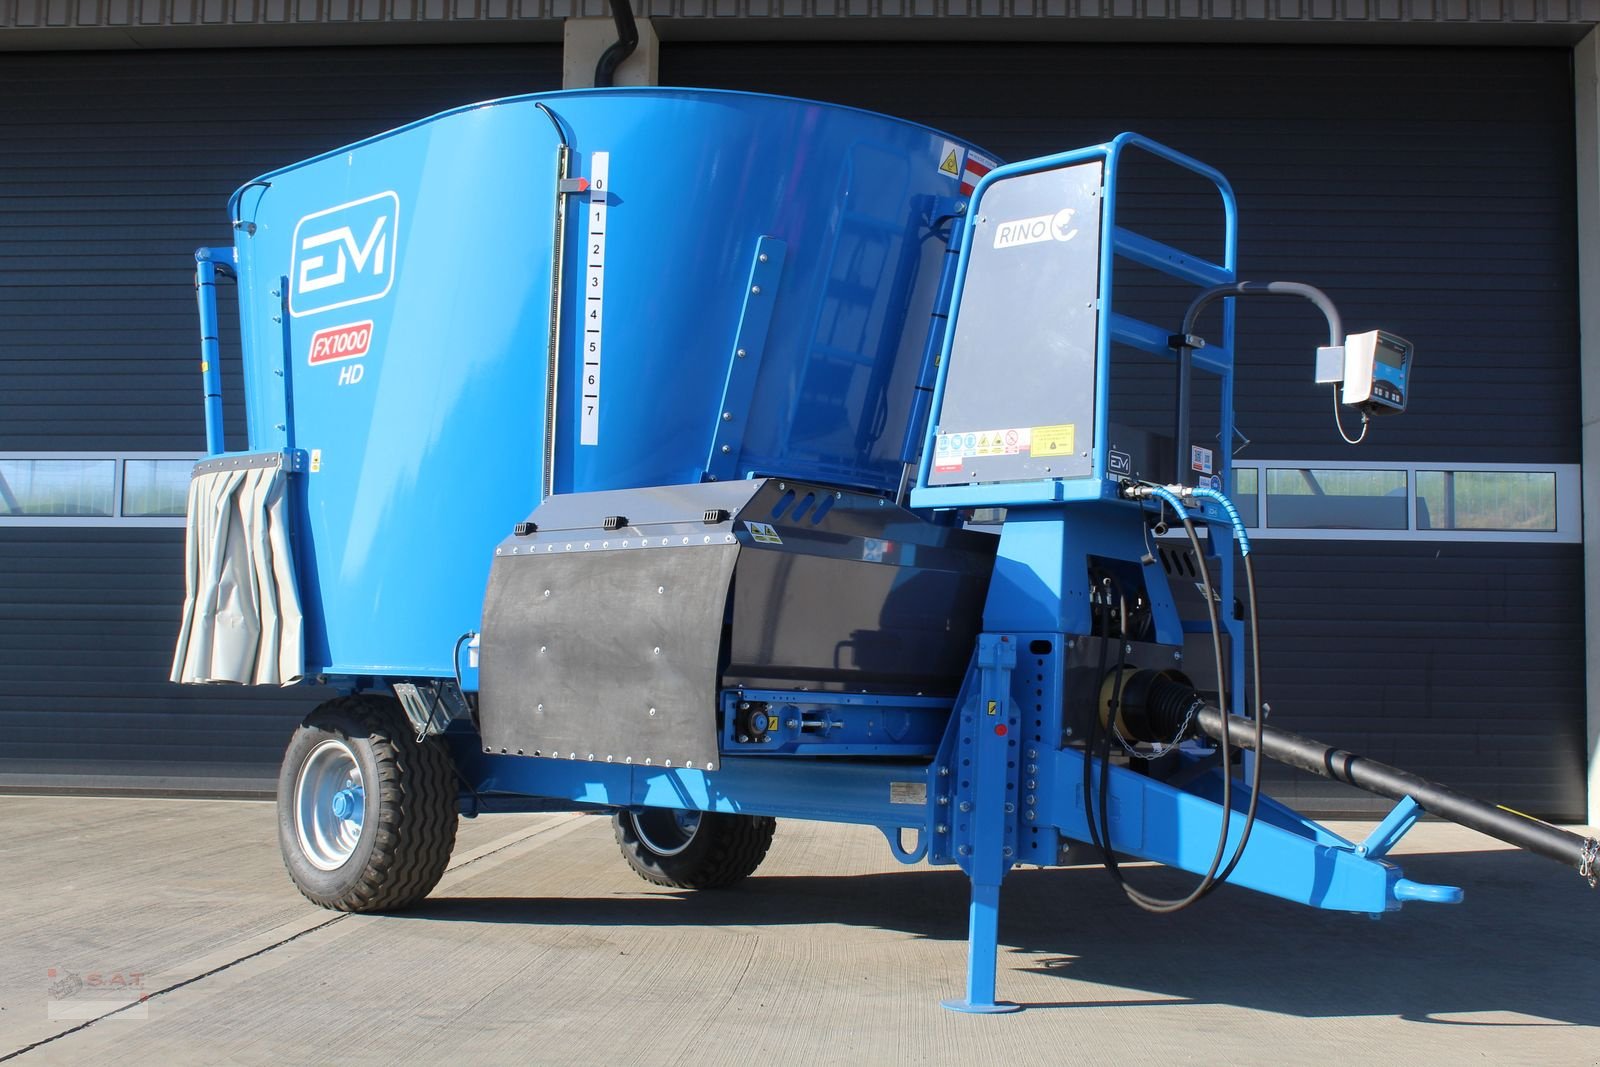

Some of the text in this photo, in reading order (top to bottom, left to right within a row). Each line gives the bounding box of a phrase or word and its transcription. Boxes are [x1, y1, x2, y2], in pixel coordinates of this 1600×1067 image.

[596, 179, 602, 189] 0
[595, 212, 600, 222] 1
[999, 220, 1046, 244] RINO
[298, 215, 388, 294] EM
[593, 244, 600, 255] 2
[591, 277, 599, 287] 3
[590, 309, 597, 320] 4
[313, 328, 368, 358] FX1000
[589, 342, 596, 352] 5
[338, 364, 364, 386] HD
[588, 374, 595, 385] 6
[587, 406, 594, 416] 7
[1110, 455, 1129, 470] EM
